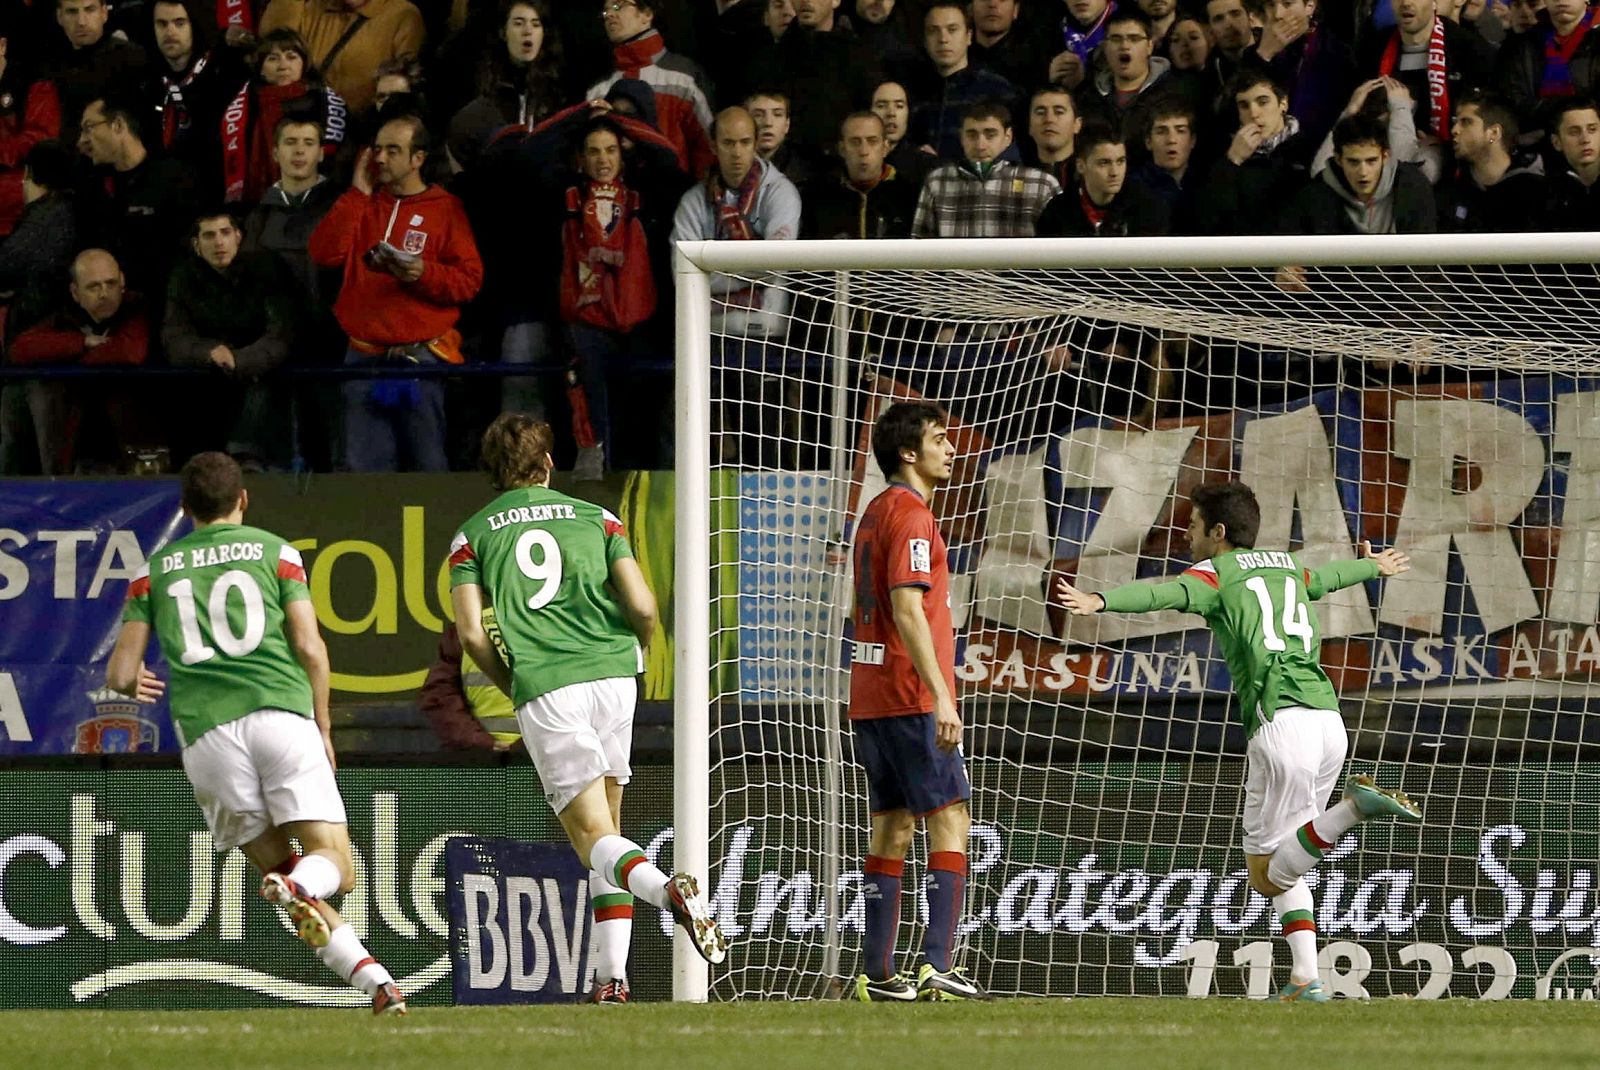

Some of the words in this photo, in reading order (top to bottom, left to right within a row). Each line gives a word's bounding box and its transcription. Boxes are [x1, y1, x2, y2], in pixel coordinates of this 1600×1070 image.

[224, 98, 245, 135] POR
[488, 504, 577, 531] LLORENTE
[162, 551, 186, 574] DE
[191, 542, 264, 569] MARCOS
[515, 529, 563, 610] 9
[1235, 551, 1297, 571] SUSAETA
[167, 570, 266, 665] 10
[1245, 576, 1314, 654] 14
[955, 643, 1203, 694] SASUNA
[1449, 824, 1600, 966] Su
